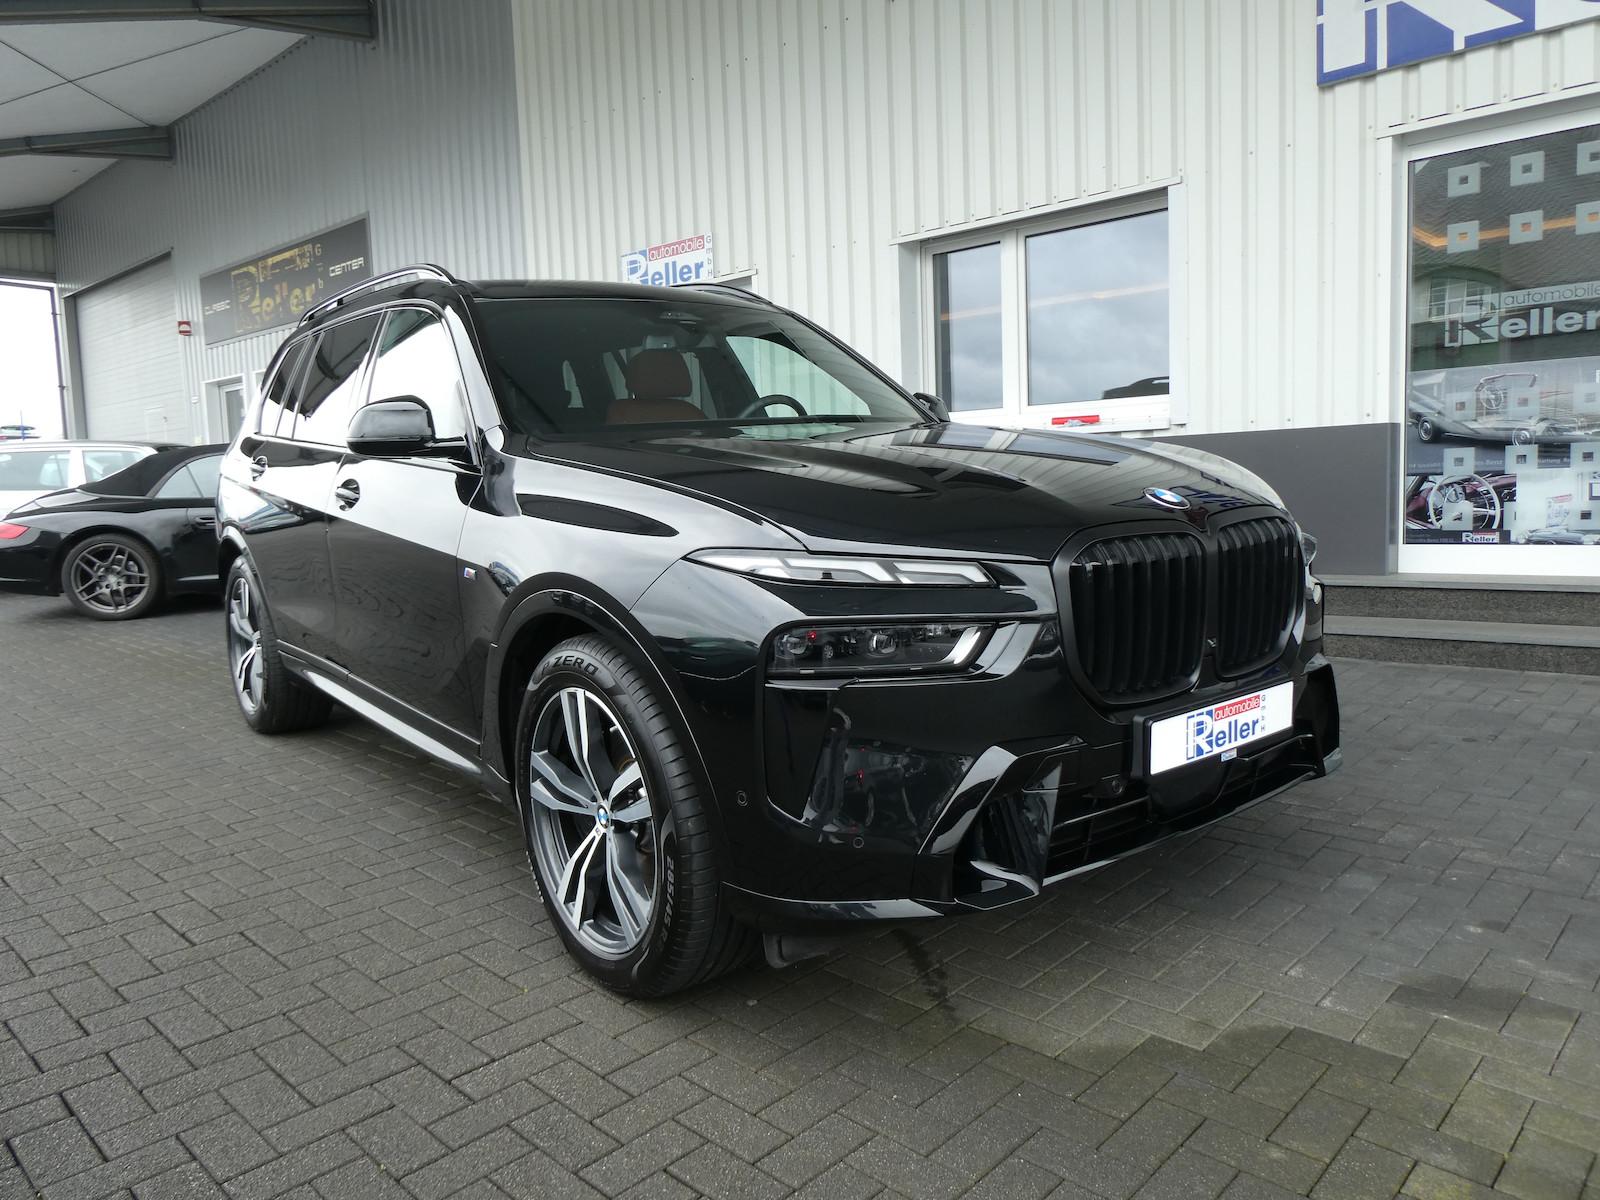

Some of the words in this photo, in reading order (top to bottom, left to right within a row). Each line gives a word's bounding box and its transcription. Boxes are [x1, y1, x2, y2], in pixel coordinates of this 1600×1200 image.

[649, 238, 704, 260] automobile
[329, 257, 365, 277] CENTER
[553, 655, 599, 676] ZERO
[1215, 695, 1260, 720] automobile
[664, 855, 675, 927] 285/45
